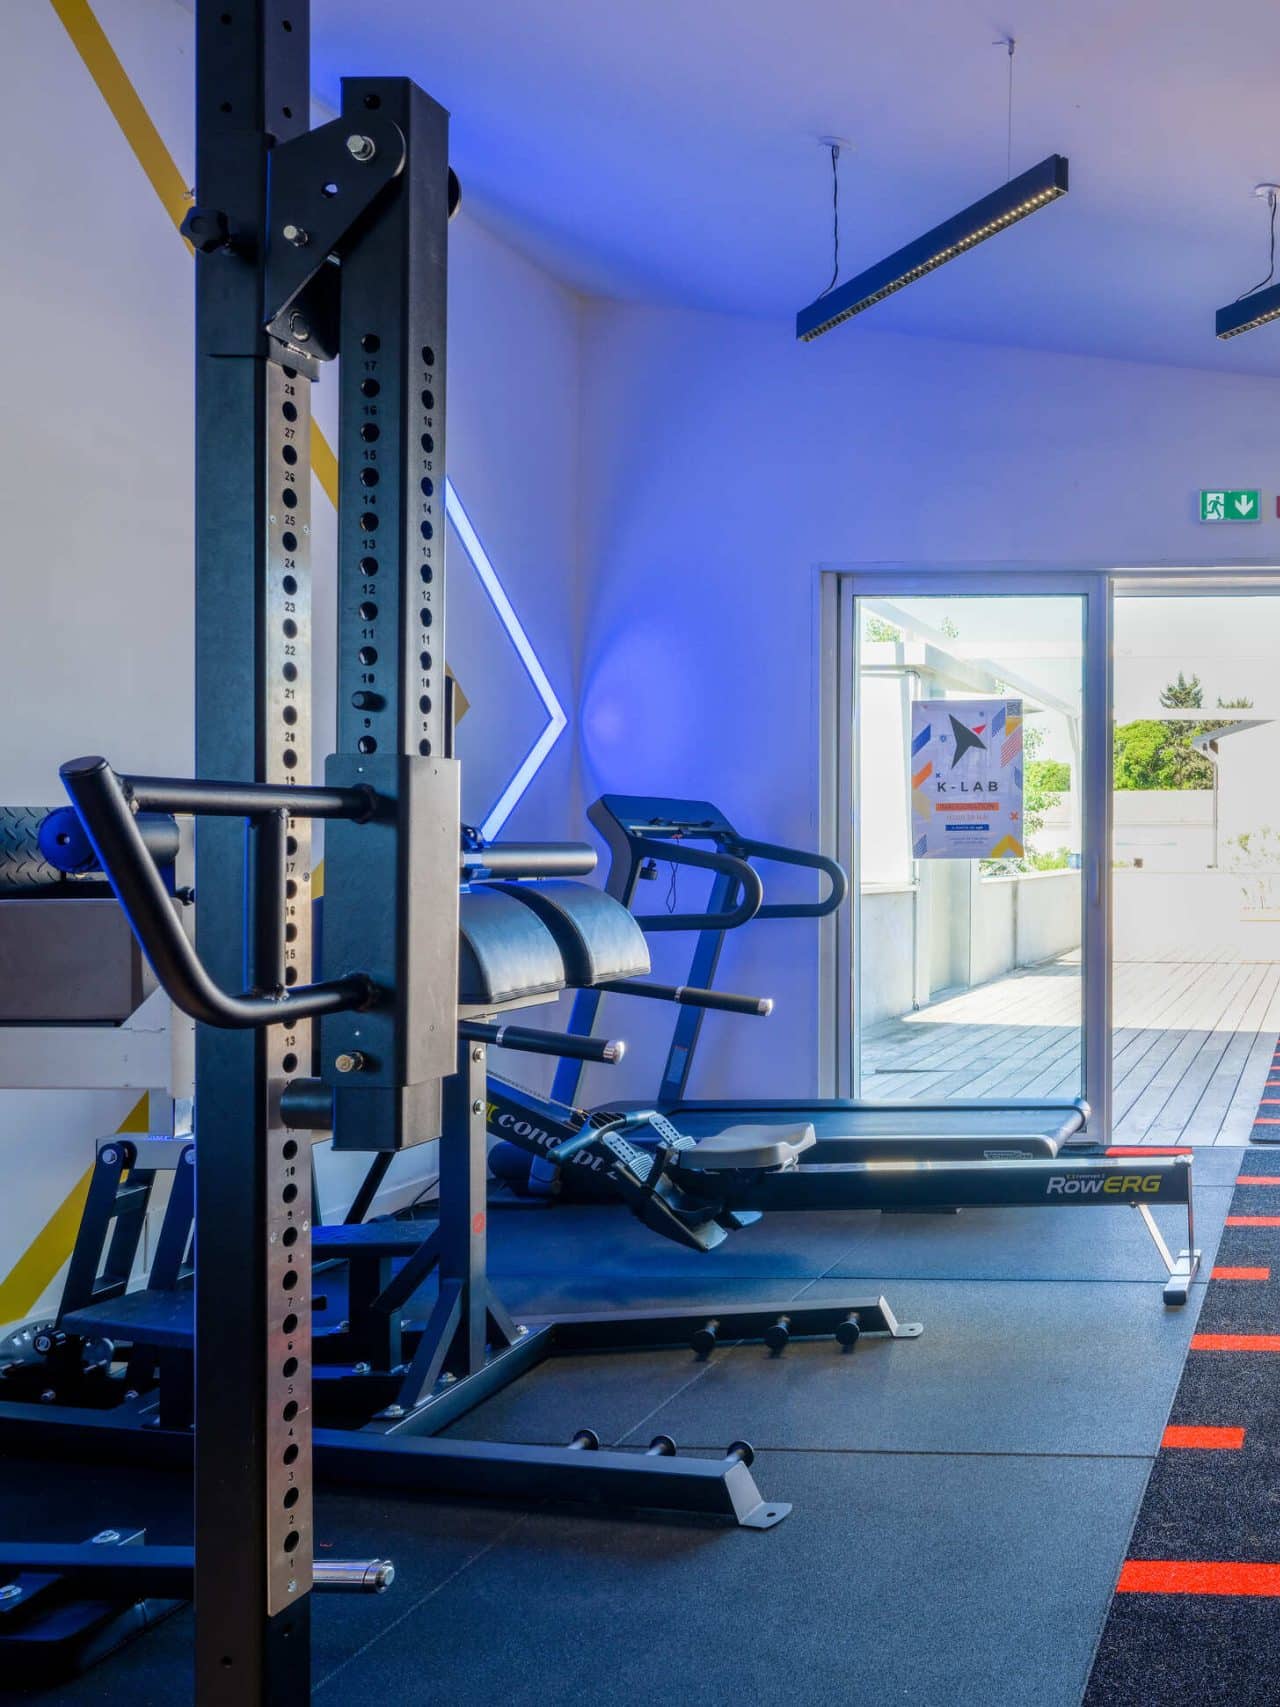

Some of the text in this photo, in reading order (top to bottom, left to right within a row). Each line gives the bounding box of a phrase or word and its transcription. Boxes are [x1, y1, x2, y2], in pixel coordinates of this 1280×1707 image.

[364, 360, 377, 370] 17
[424, 372, 432, 384] 17
[363, 405, 377, 416] 16
[424, 416, 432, 427] 16
[285, 428, 295, 438] 27
[363, 450, 376, 460] 15
[423, 460, 432, 471] 15
[285, 471, 295, 482] 26
[363, 495, 376, 504] 14
[423, 503, 431, 514] 14
[285, 515, 295, 526] 25
[363, 539, 376, 549] 13
[423, 547, 431, 558] 13
[285, 558, 295, 568] 24
[363, 584, 375, 594] 12
[422, 590, 430, 601] 12
[285, 601, 295, 612] 23
[362, 629, 374, 639] 11
[422, 633, 429, 645] 11
[285, 645, 295, 656] 22
[362, 674, 374, 683] 10
[285, 688, 294, 699] 21
[285, 732, 295, 742] 20
[937, 781, 999, 792] K-LAB
[285, 949, 295, 959] 15
[285, 1036, 295, 1046] 13
[498, 1113, 605, 1172] concpt
